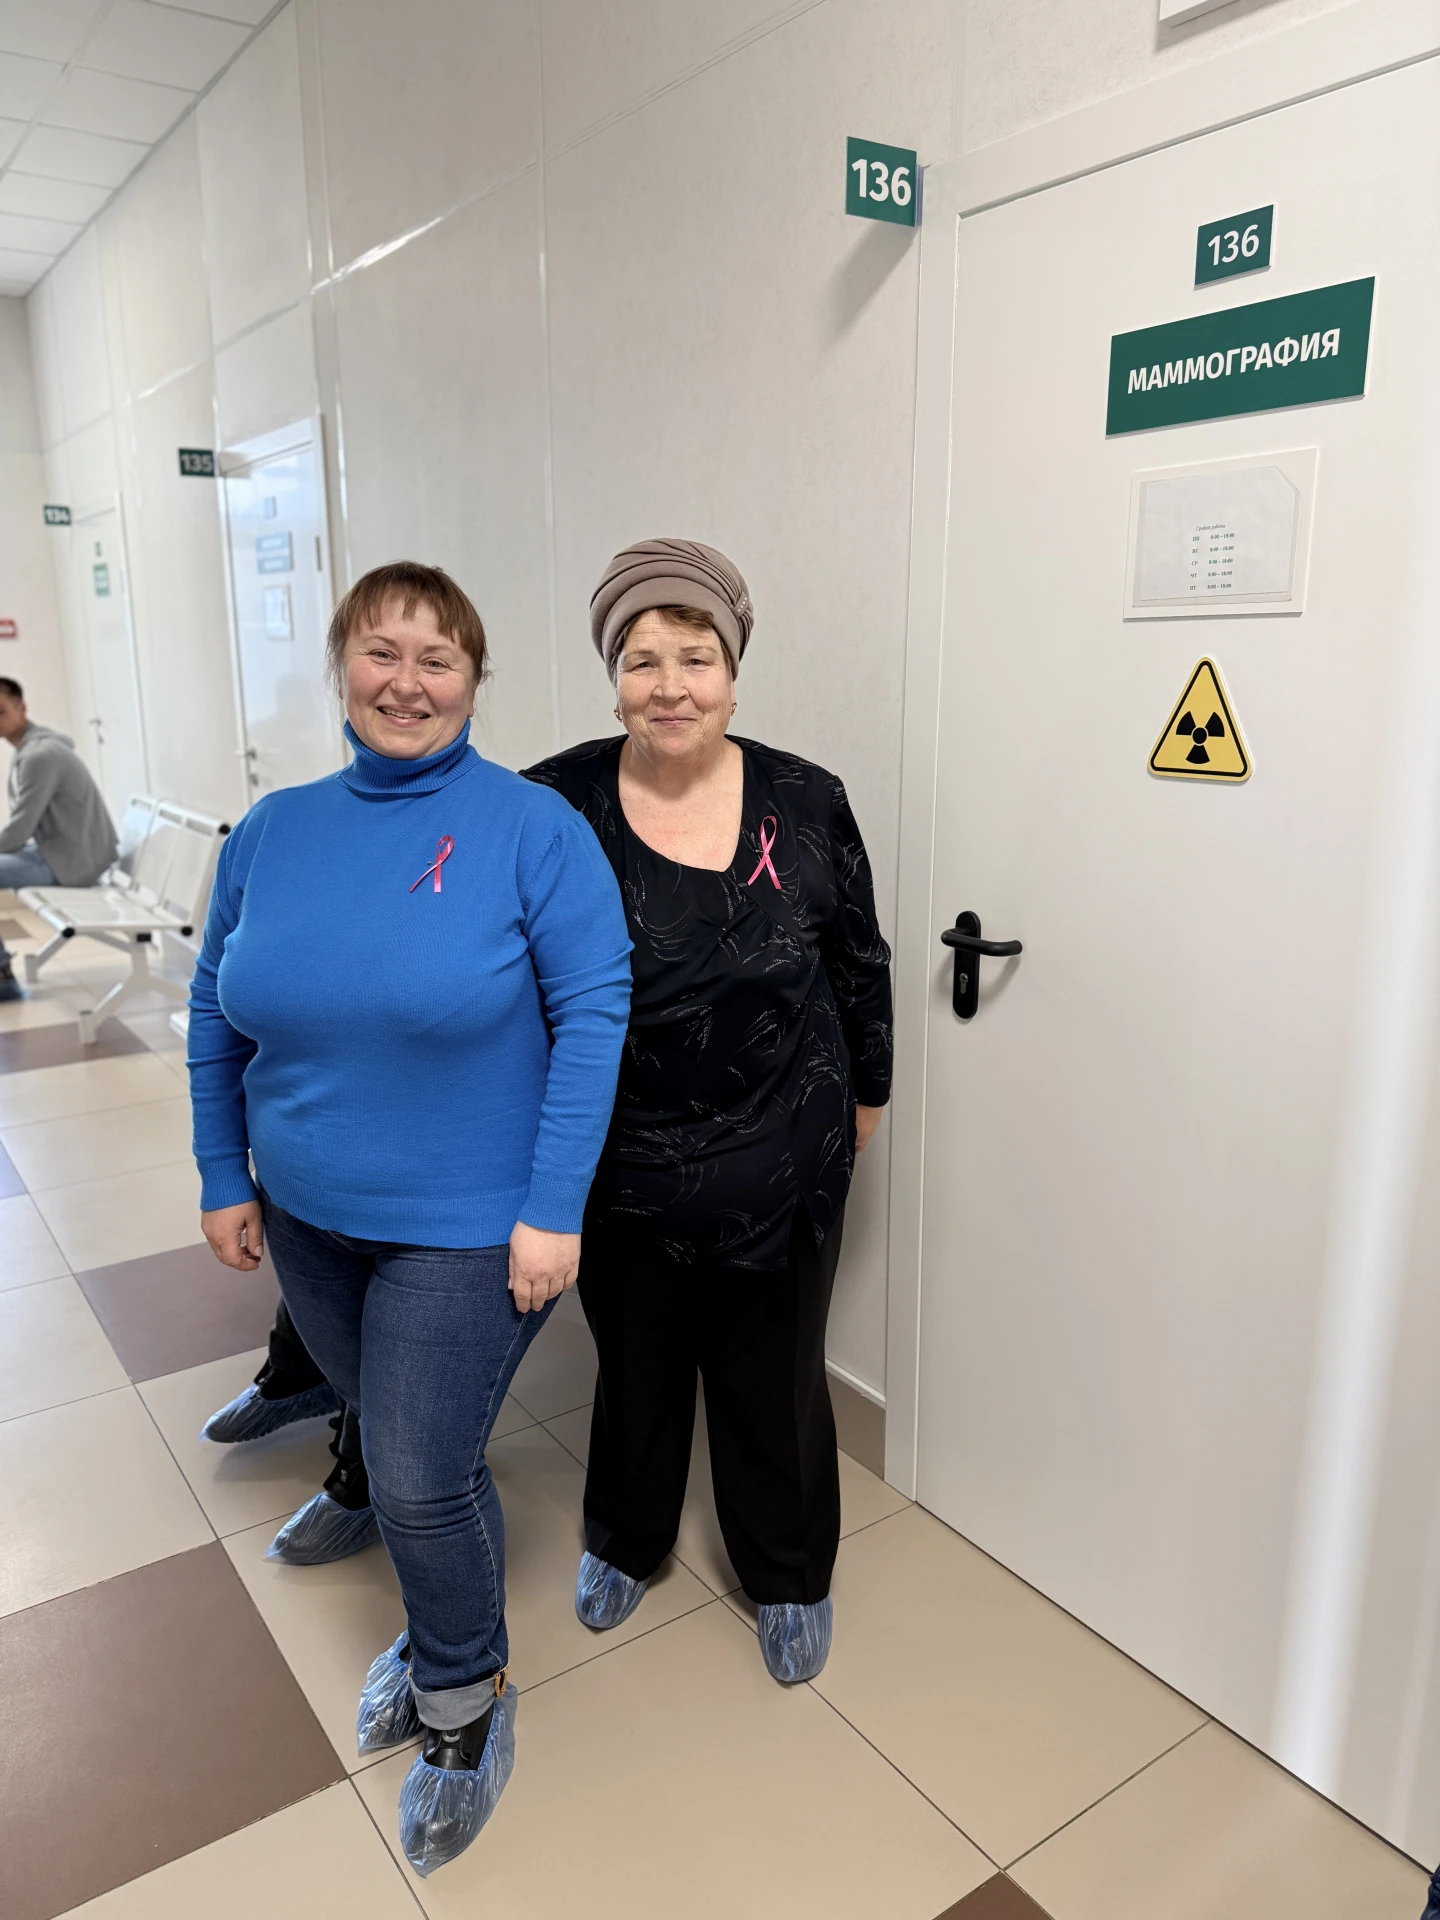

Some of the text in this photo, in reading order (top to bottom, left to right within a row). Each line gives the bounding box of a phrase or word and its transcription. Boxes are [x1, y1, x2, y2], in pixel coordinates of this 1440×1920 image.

[851, 158, 912, 207] 136
[1207, 224, 1260, 266] 136
[1127, 328, 1341, 394] МАММОГРАФИЯ
[180, 453, 213, 472] 135
